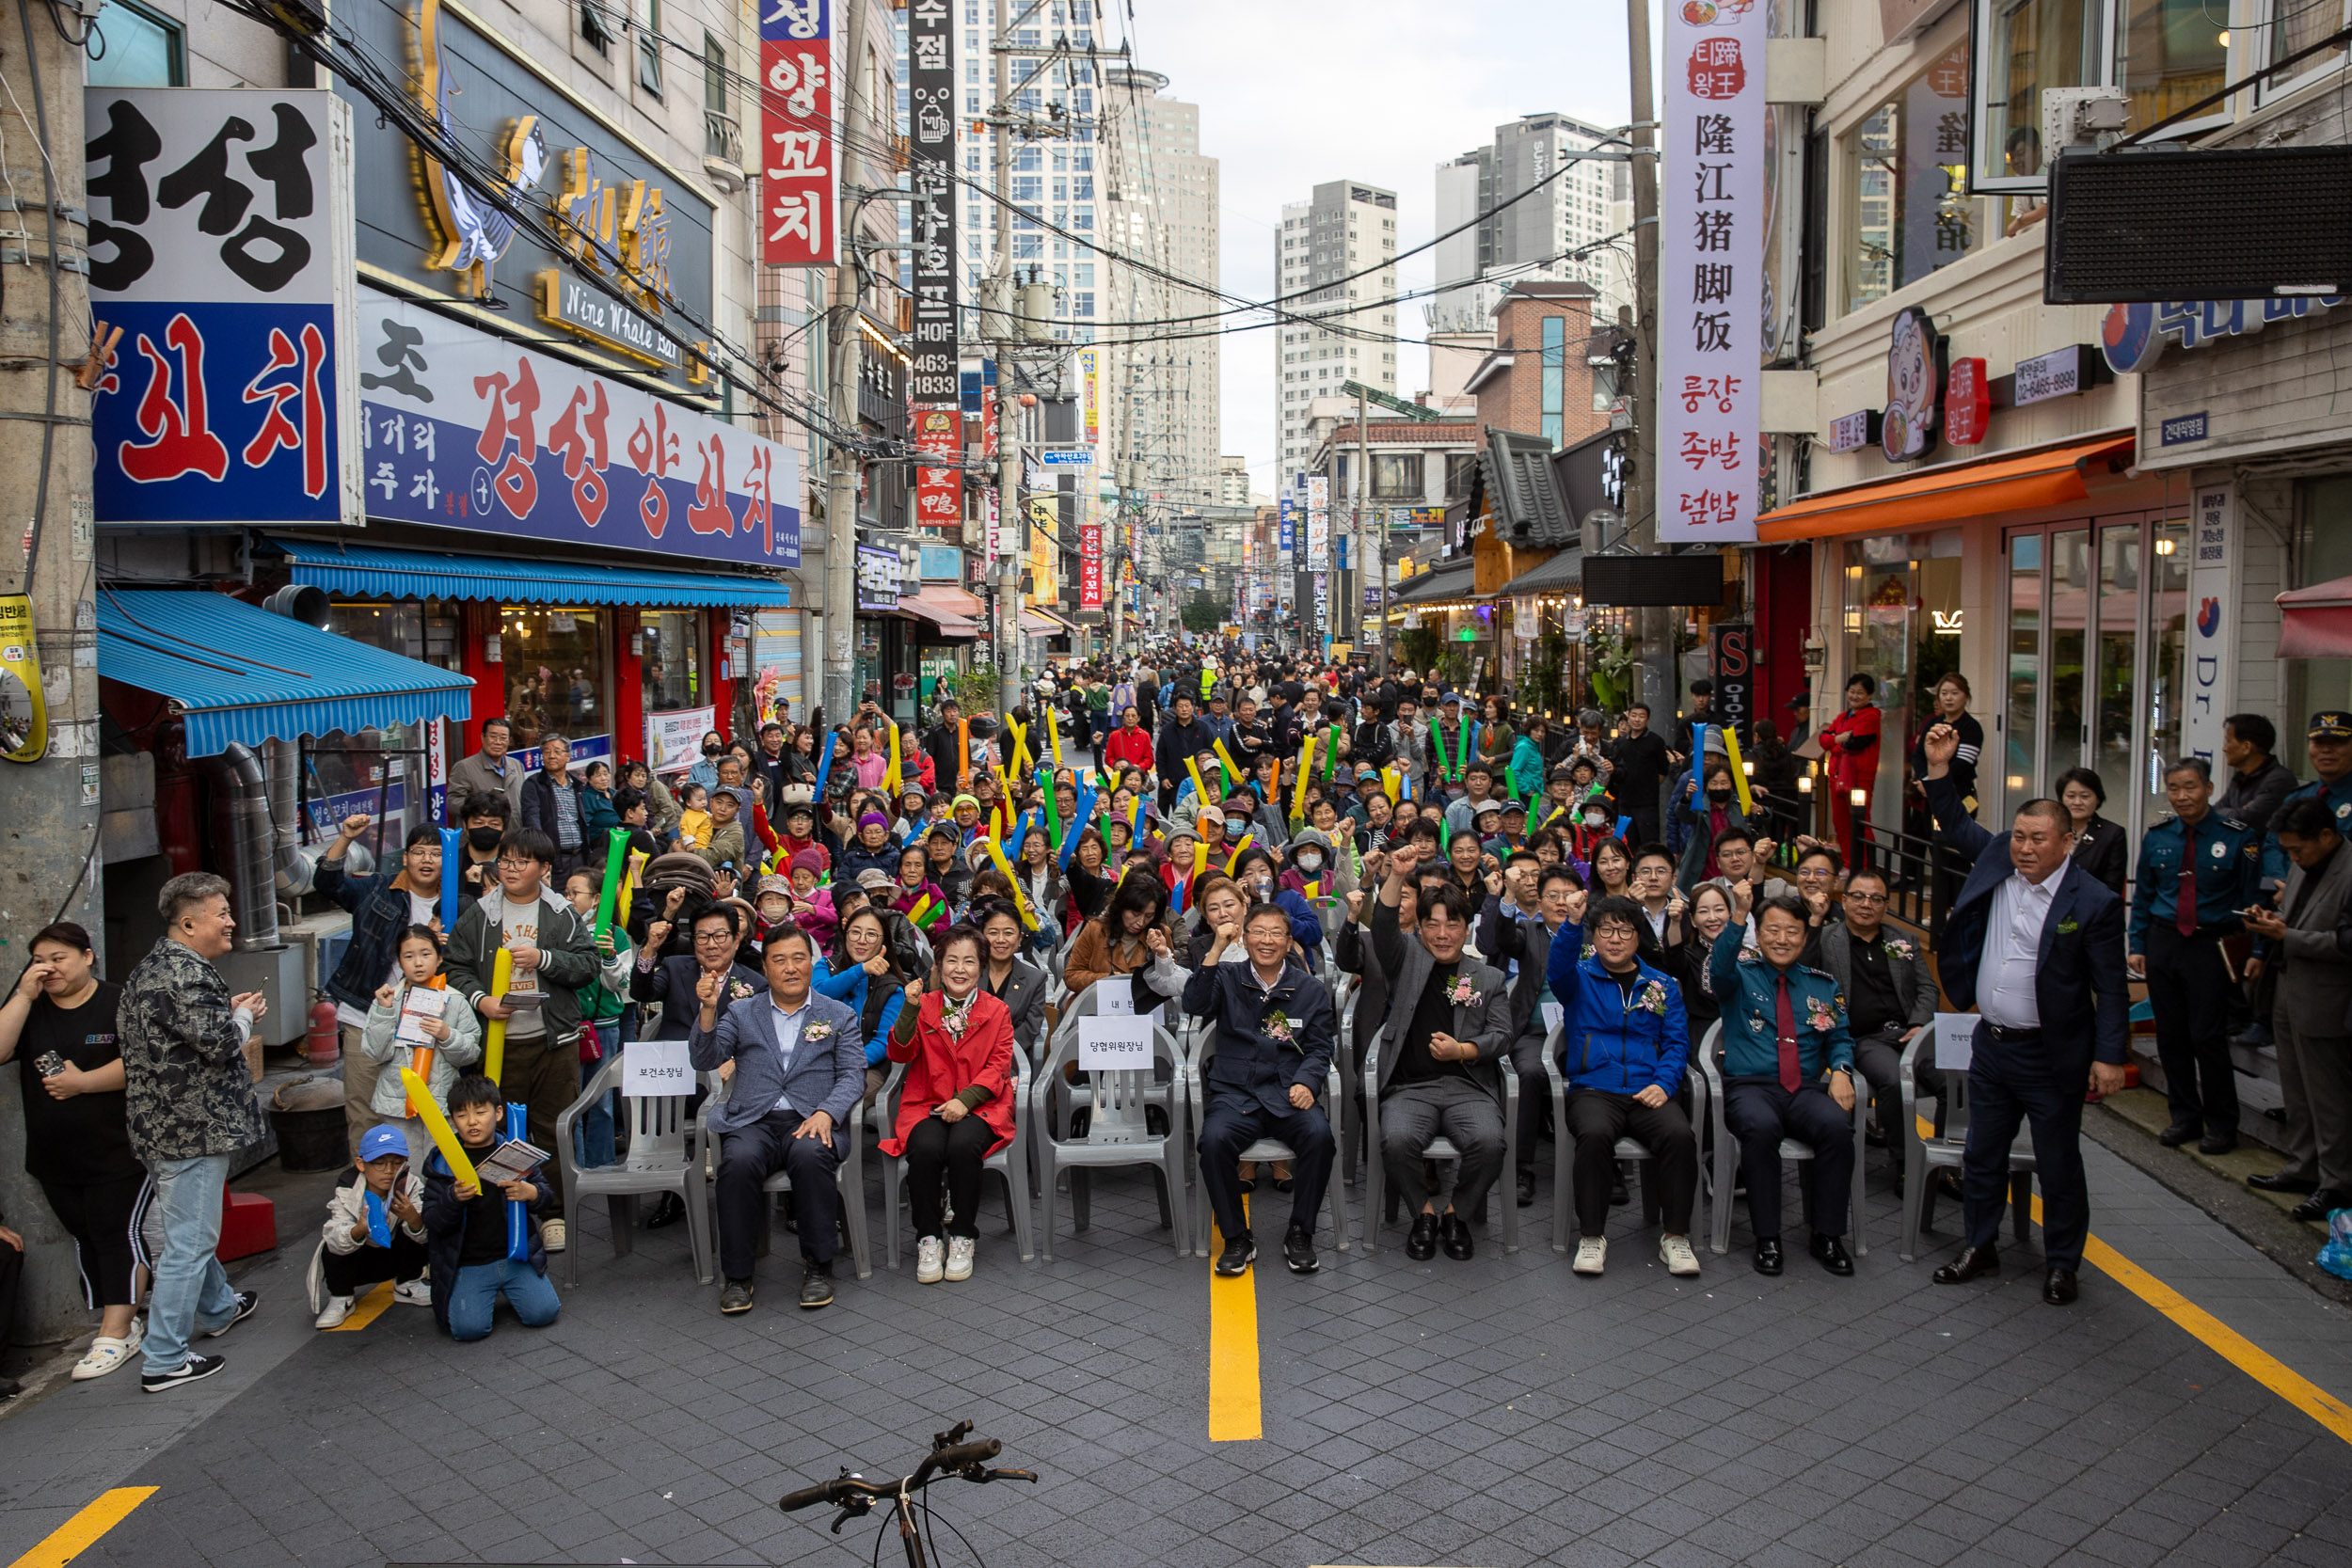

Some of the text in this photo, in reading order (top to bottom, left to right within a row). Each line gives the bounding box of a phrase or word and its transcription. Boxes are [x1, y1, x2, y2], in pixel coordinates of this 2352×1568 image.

[1692, 114, 1735, 353] 隆江猪脚饭
[566, 284, 606, 328] Nine
[610, 302, 653, 350] Whale
[916, 323, 953, 342] HOF
[914, 354, 957, 372] 463-
[914, 376, 955, 394] 1833
[90, 311, 328, 500] 꼬치
[1680, 431, 1740, 470] 족발
[370, 462, 440, 511] 주자
[1680, 488, 1740, 526] 덮밥
[515, 924, 538, 942] THE
[1111, 1000, 1120, 1009] 내
[87, 1035, 115, 1044] BEAR
[1089, 1041, 1144, 1053] 당협위원장님
[639, 1067, 683, 1079] 보건소장님
